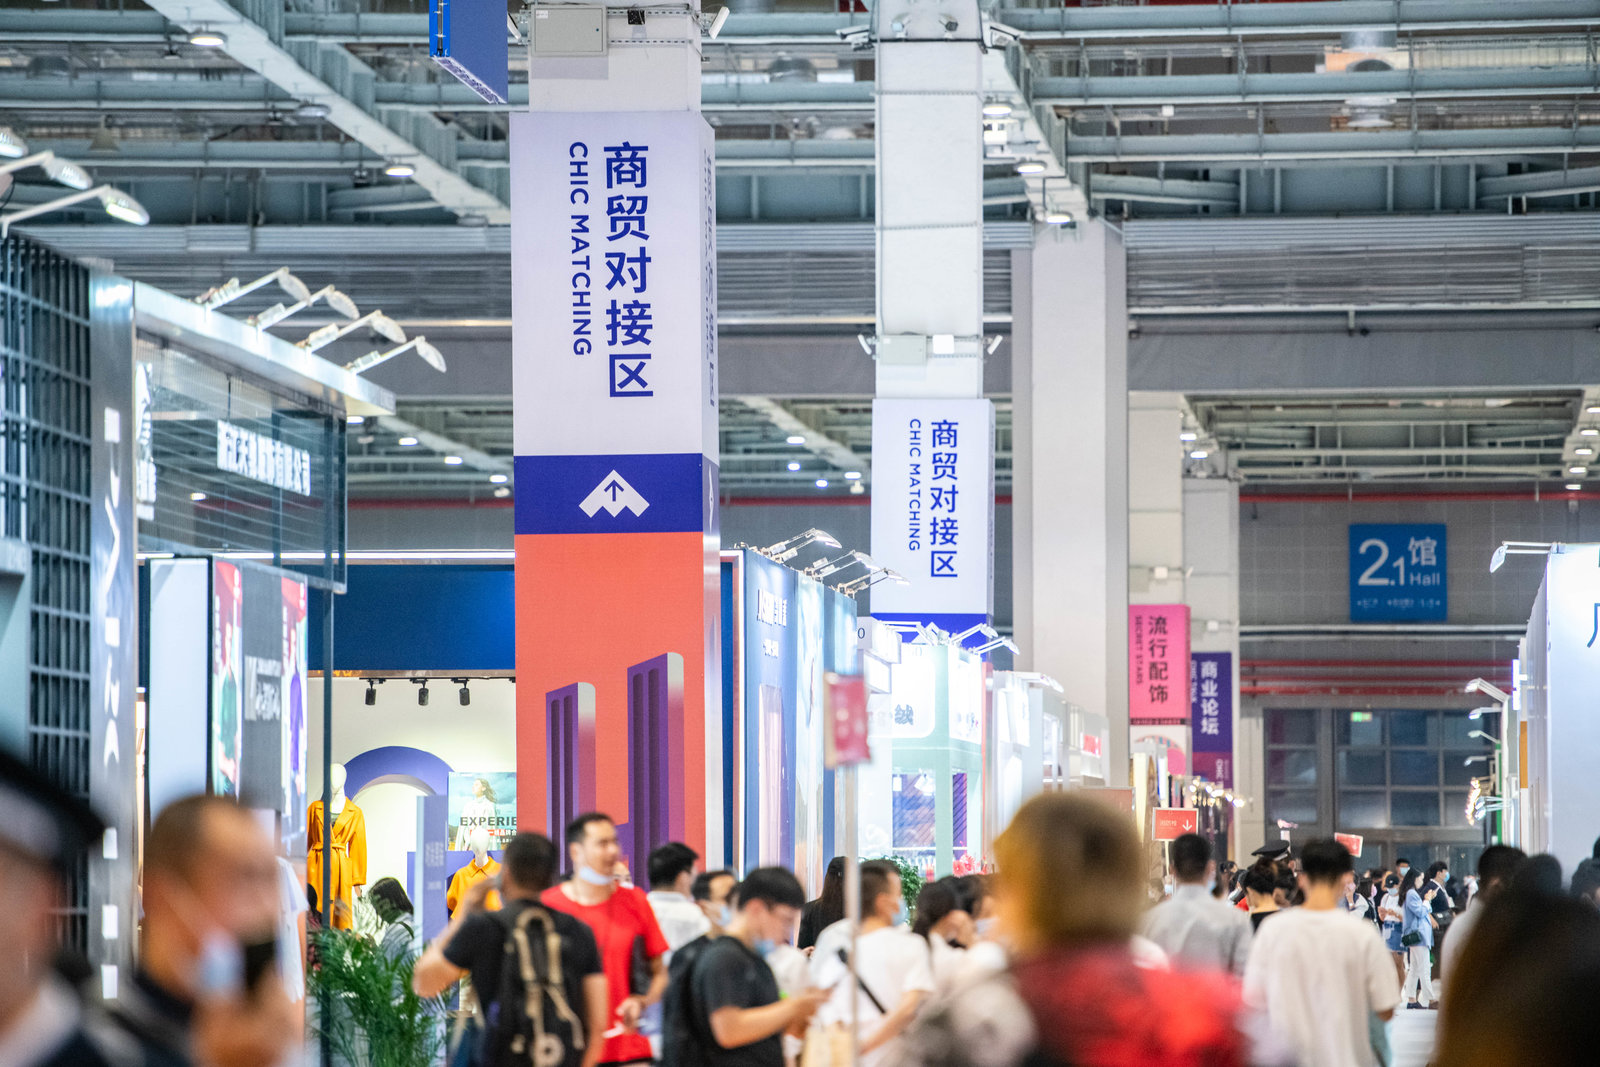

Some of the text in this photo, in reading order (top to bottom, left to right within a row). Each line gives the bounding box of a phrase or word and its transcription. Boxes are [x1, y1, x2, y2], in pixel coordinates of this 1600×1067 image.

[569, 141, 592, 356] CHIC MATCHING
[604, 141, 653, 397] 商贸对接区
[908, 418, 921, 551] CHIC MATCHING
[930, 419, 959, 578] 商贸对接区
[1358, 536, 1438, 586] 2.1 馆
[1410, 572, 1440, 586] Hall
[1149, 615, 1168, 704] 流行配饰
[1201, 660, 1219, 736] 商业论坛
